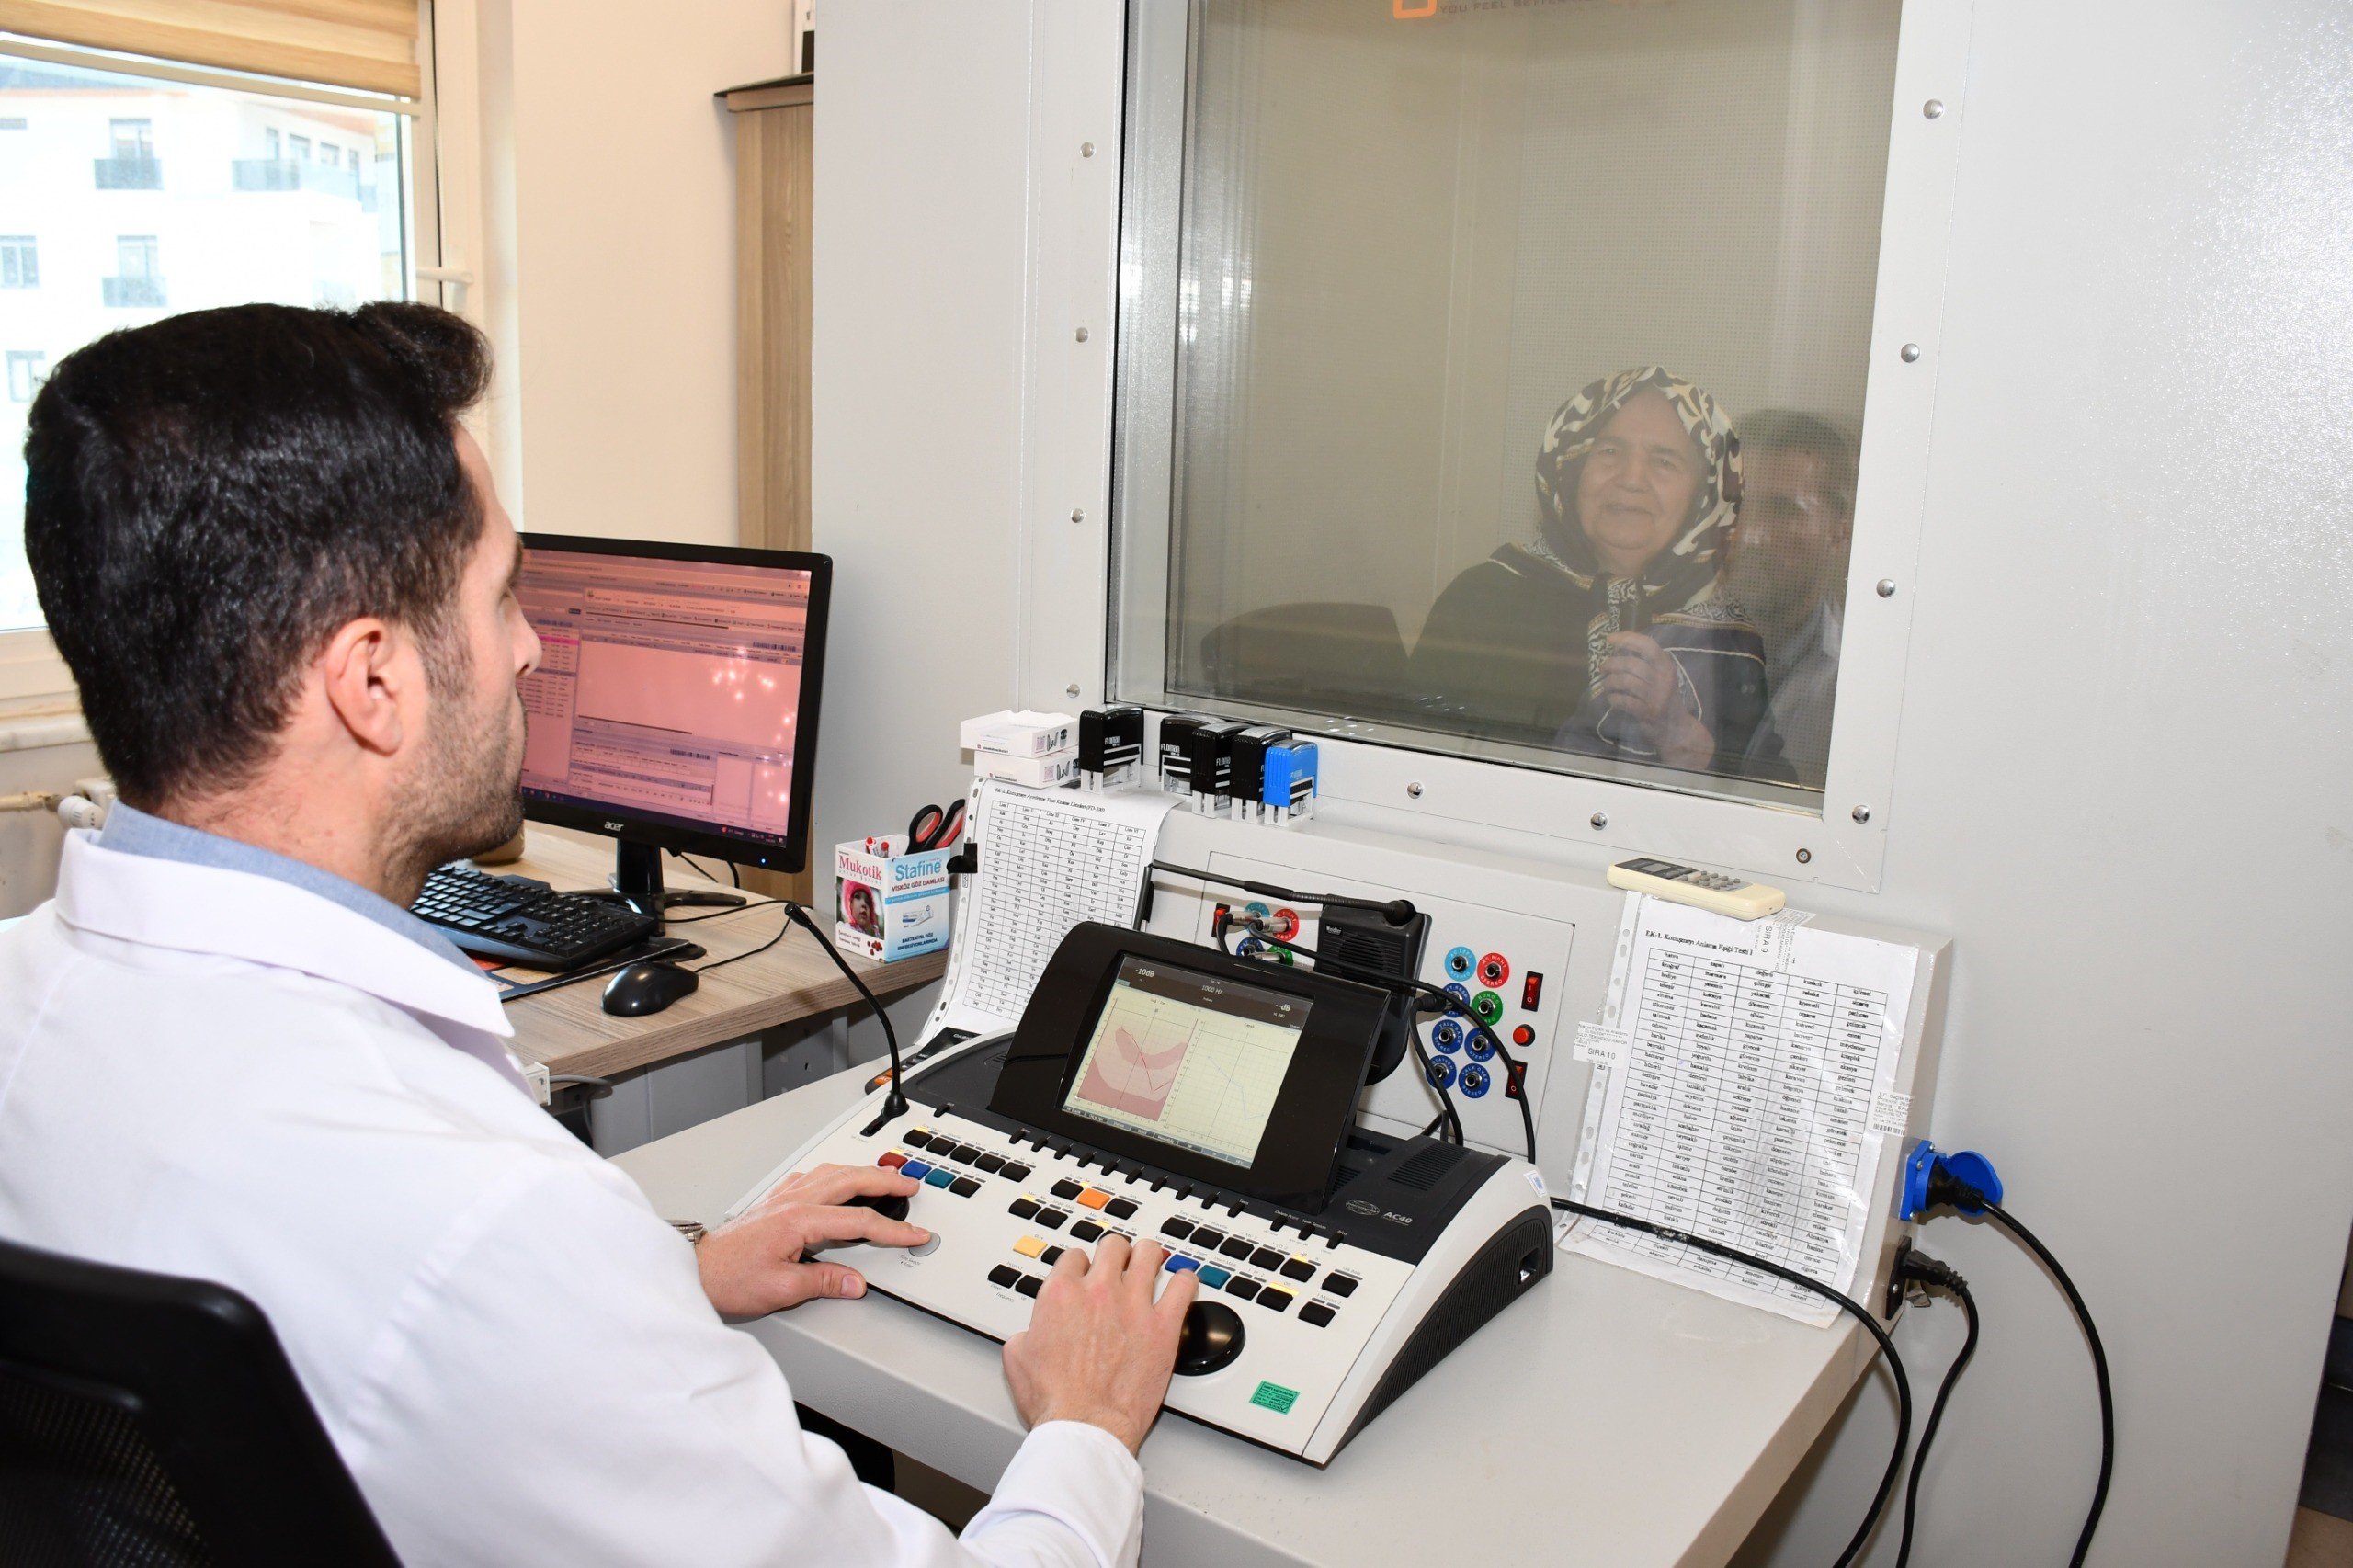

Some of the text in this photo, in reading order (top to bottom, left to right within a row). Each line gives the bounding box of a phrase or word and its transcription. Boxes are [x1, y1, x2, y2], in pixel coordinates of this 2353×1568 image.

[1440, 5, 1468, 14] YOU
[1473, 2, 1507, 11] FEEL
[604, 821, 624, 832] acer
[838, 855, 882, 881] Mukotik
[895, 860, 942, 881] Stafine
[911, 881, 922, 890] GÖZ
[922, 876, 945, 886] DAMLASI
[1762, 926, 1773, 946] SIRA
[1696, 940, 1717, 949] Anlama
[1734, 946, 1749, 955] Testi
[1492, 955, 1507, 969] RIGHT
[1135, 968, 1155, 978] -10dB
[1480, 975, 1503, 986] STEREO
[1201, 984, 1214, 993] 1000
[1469, 1051, 1490, 1060] STEREO
[1588, 1048, 1605, 1058] SIRA
[1461, 1066, 1488, 1083] TALK OVER
[1462, 1085, 1482, 1096] STEREO
[1383, 1211, 1413, 1224] AC40
